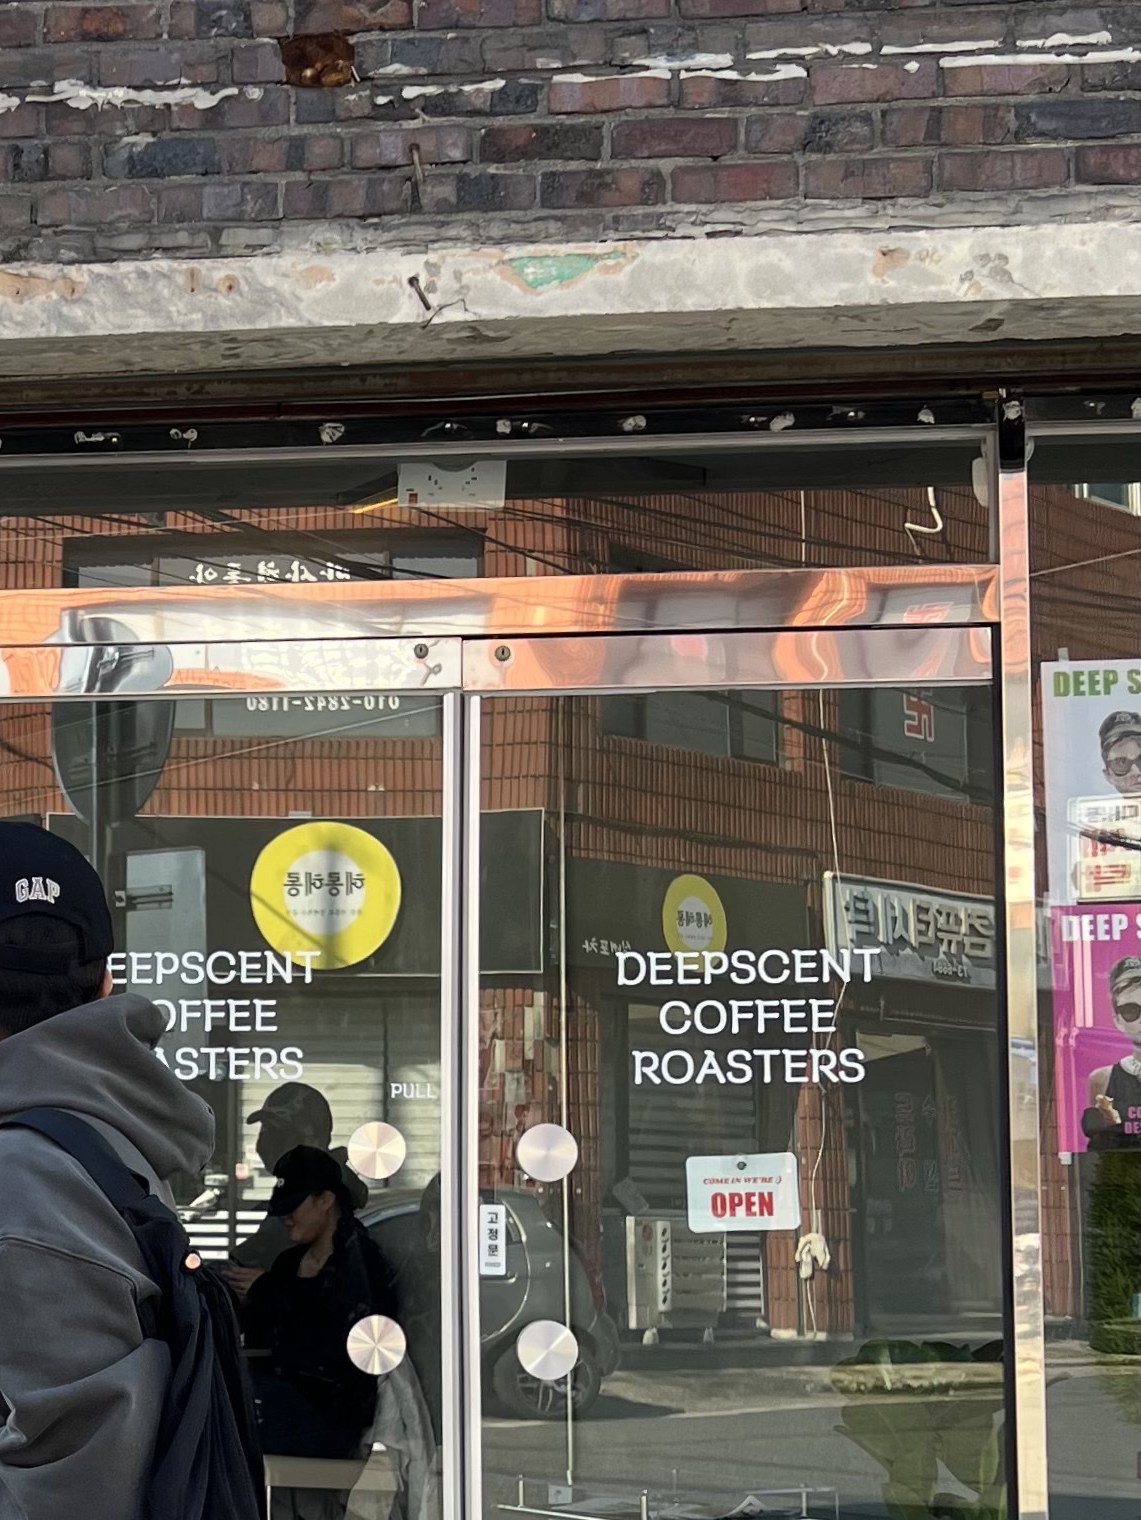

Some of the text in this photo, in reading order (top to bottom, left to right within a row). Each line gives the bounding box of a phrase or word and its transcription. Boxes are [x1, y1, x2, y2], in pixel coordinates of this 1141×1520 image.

[1053, 669, 1119, 697] DEEP
[15, 876, 60, 904] GAP
[1061, 913, 1129, 942] DEEP
[106, 950, 322, 985] EEPSCENT
[616, 948, 881, 986] DEEPSCENT
[151, 999, 278, 1033] OFFEE
[659, 998, 836, 1035] COFFEE
[632, 1048, 865, 1085] ROASTERS
[390, 1082, 438, 1099] PULL
[703, 1177, 730, 1185] COME
[711, 1191, 774, 1218] OPEN
